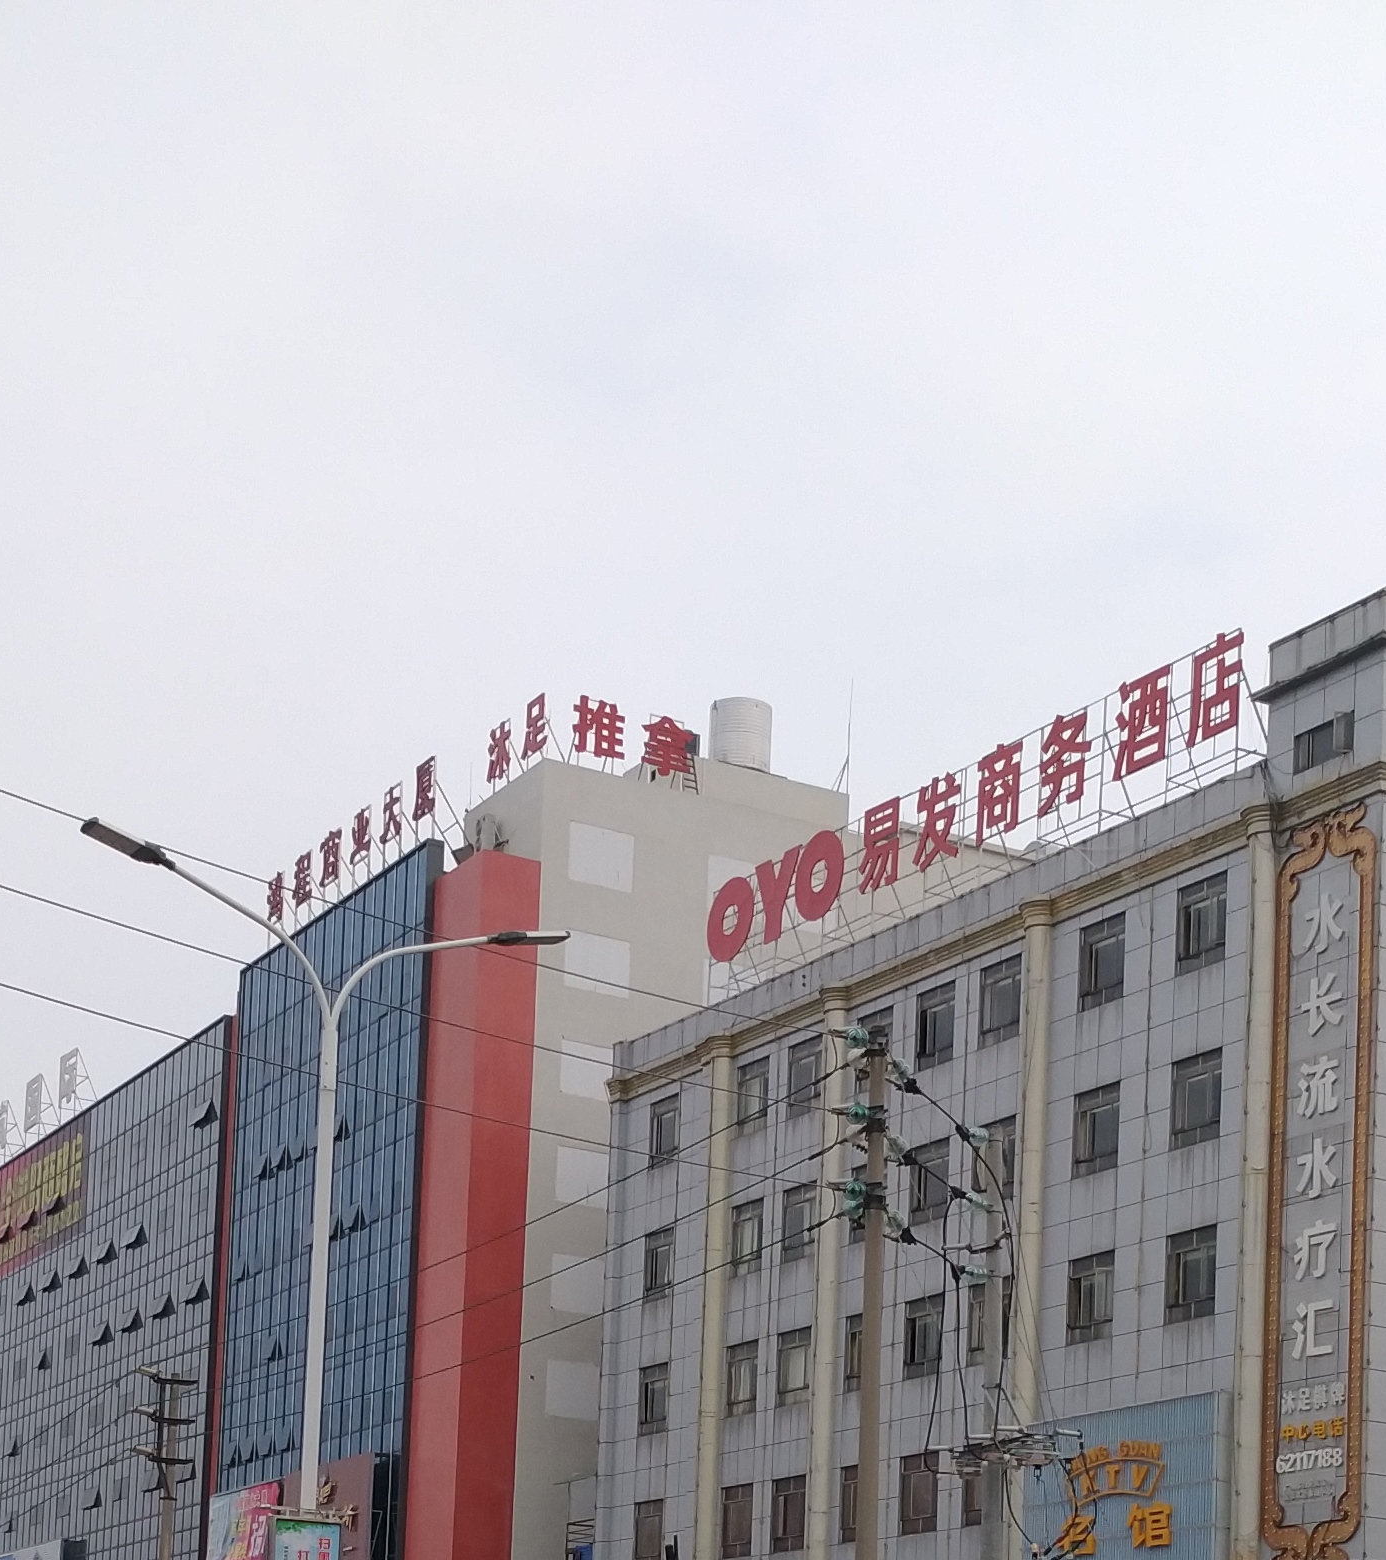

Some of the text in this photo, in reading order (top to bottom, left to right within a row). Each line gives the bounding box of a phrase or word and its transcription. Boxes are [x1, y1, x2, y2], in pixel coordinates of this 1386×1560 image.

[707, 631, 1244, 963] OYO 易发商务酒店
[1291, 891, 1346, 1363] 水长流水疗汇
[1281, 1416, 1346, 1444] 中心电话
[1275, 1447, 1343, 1474] 62117188
[1057, 1501, 1173, 1556] 名馆
